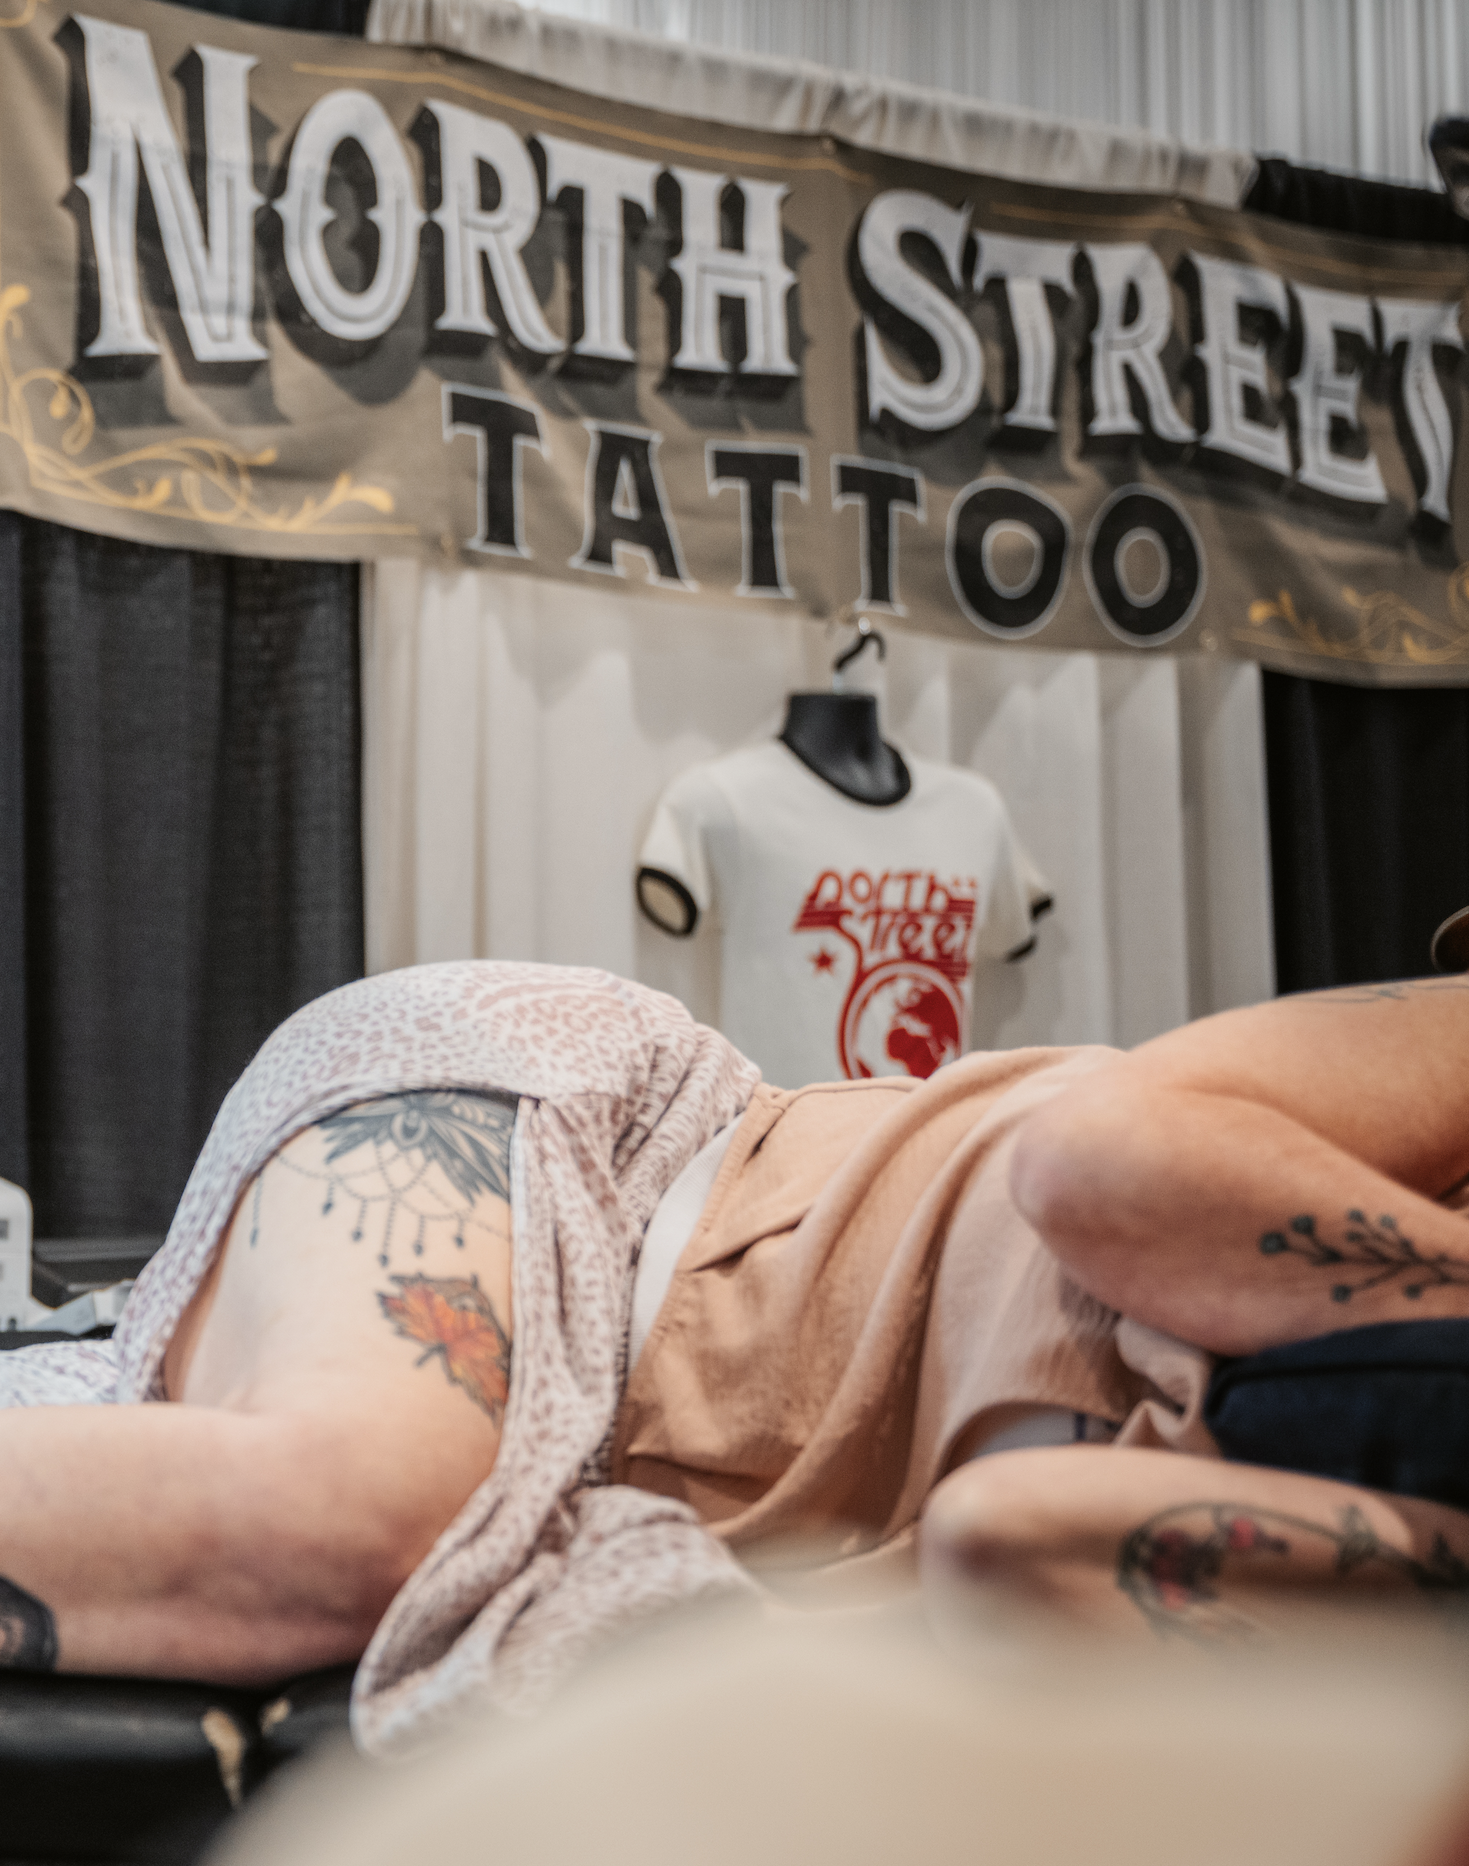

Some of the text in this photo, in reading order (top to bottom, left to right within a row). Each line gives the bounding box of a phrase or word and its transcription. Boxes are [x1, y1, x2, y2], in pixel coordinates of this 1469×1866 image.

[69, 14, 1460, 522] NORTH STREET
[441, 382, 1207, 648] TATTOO
